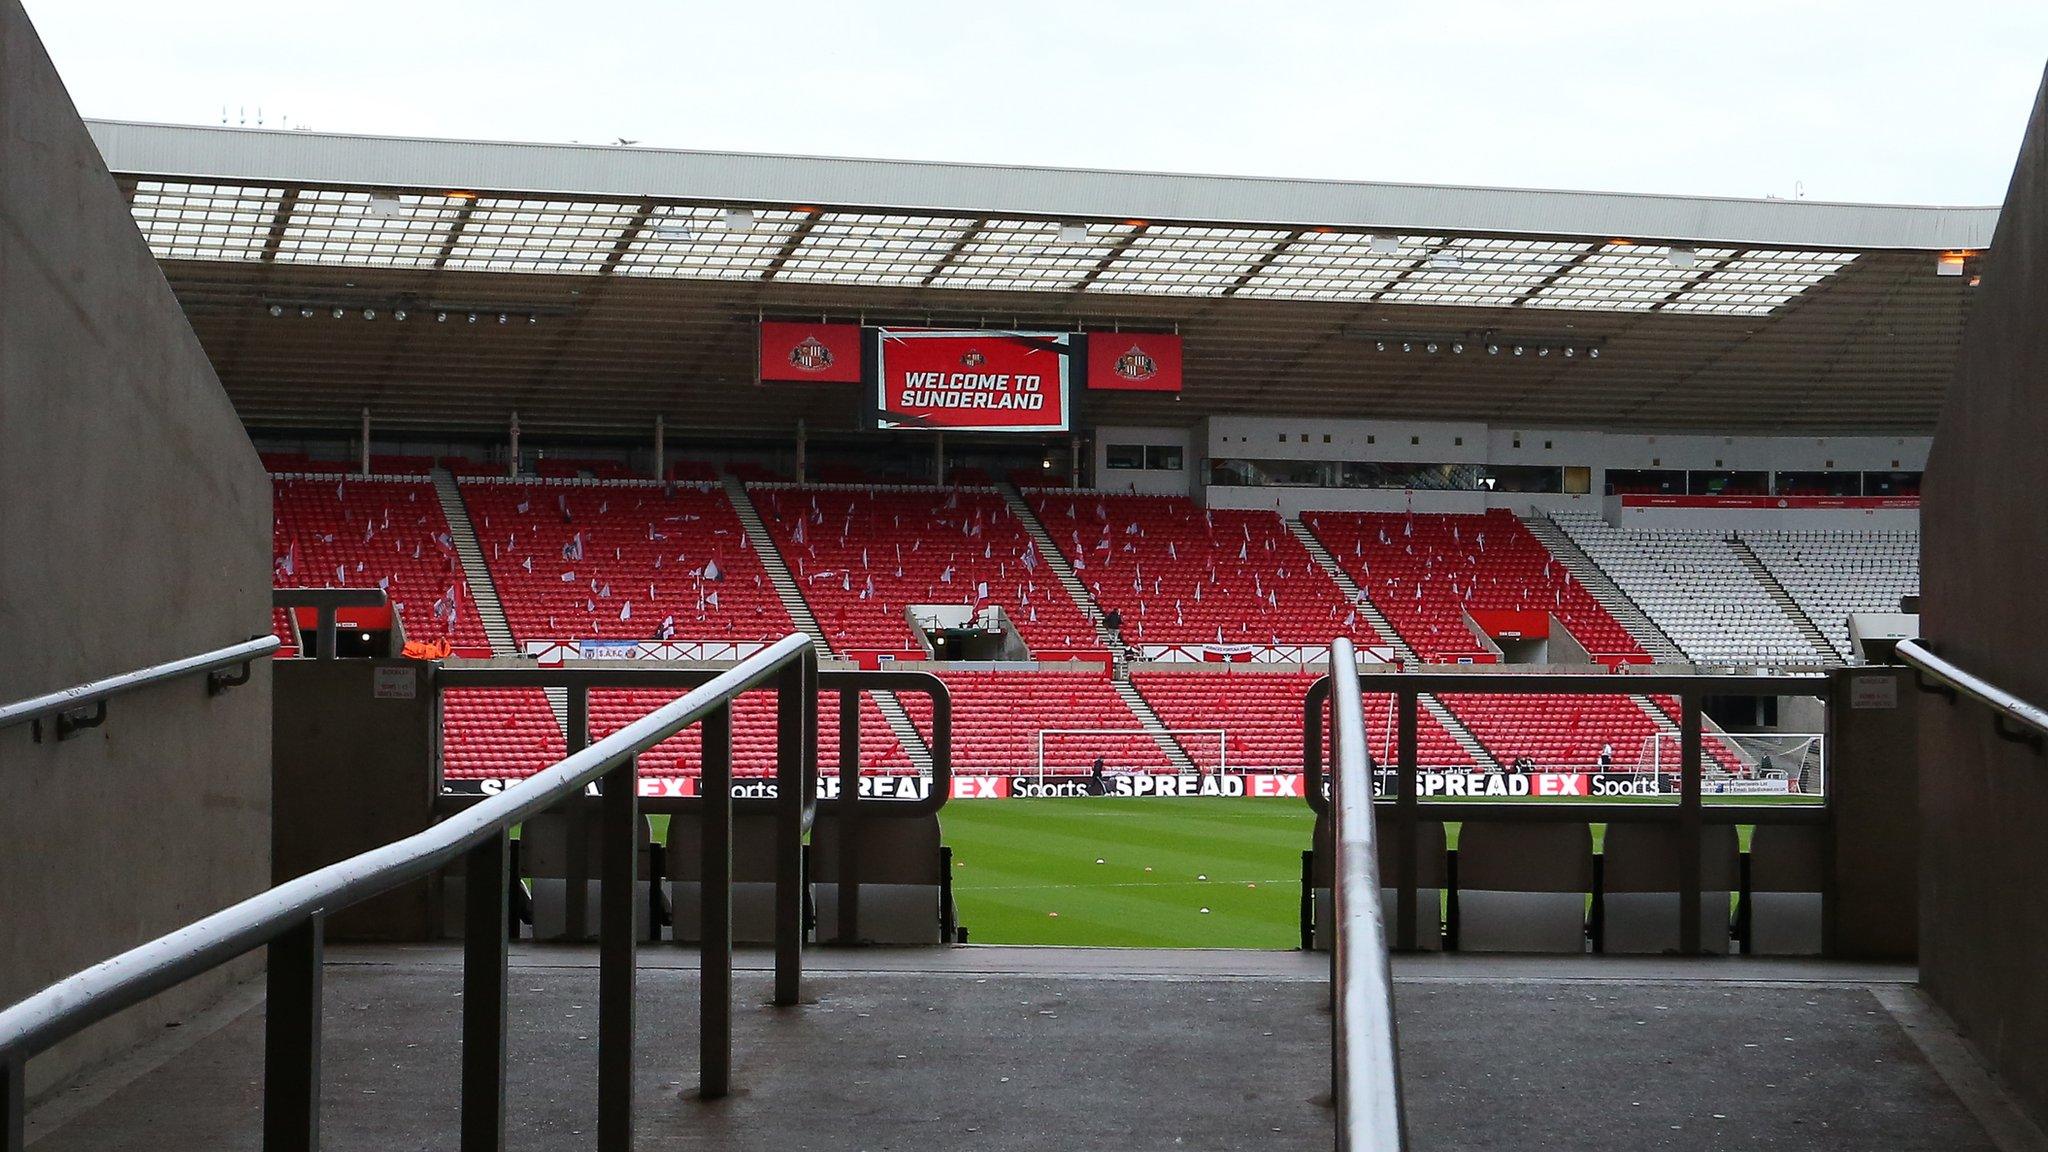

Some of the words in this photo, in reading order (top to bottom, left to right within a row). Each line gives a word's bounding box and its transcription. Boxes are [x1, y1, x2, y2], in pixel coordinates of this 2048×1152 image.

[905, 372, 1010, 391] WELCOME
[1014, 374, 1041, 392] TO
[901, 390, 1044, 410] SUNDERLAND
[638, 777, 685, 797] EX
[731, 781, 778, 798] orts
[954, 776, 999, 798] EX
[1013, 777, 1089, 798] Sports
[1115, 776, 1244, 797] SPREAD
[1255, 774, 1298, 797] EX
[1539, 774, 1581, 797] EX
[1592, 774, 1660, 797] Sports
